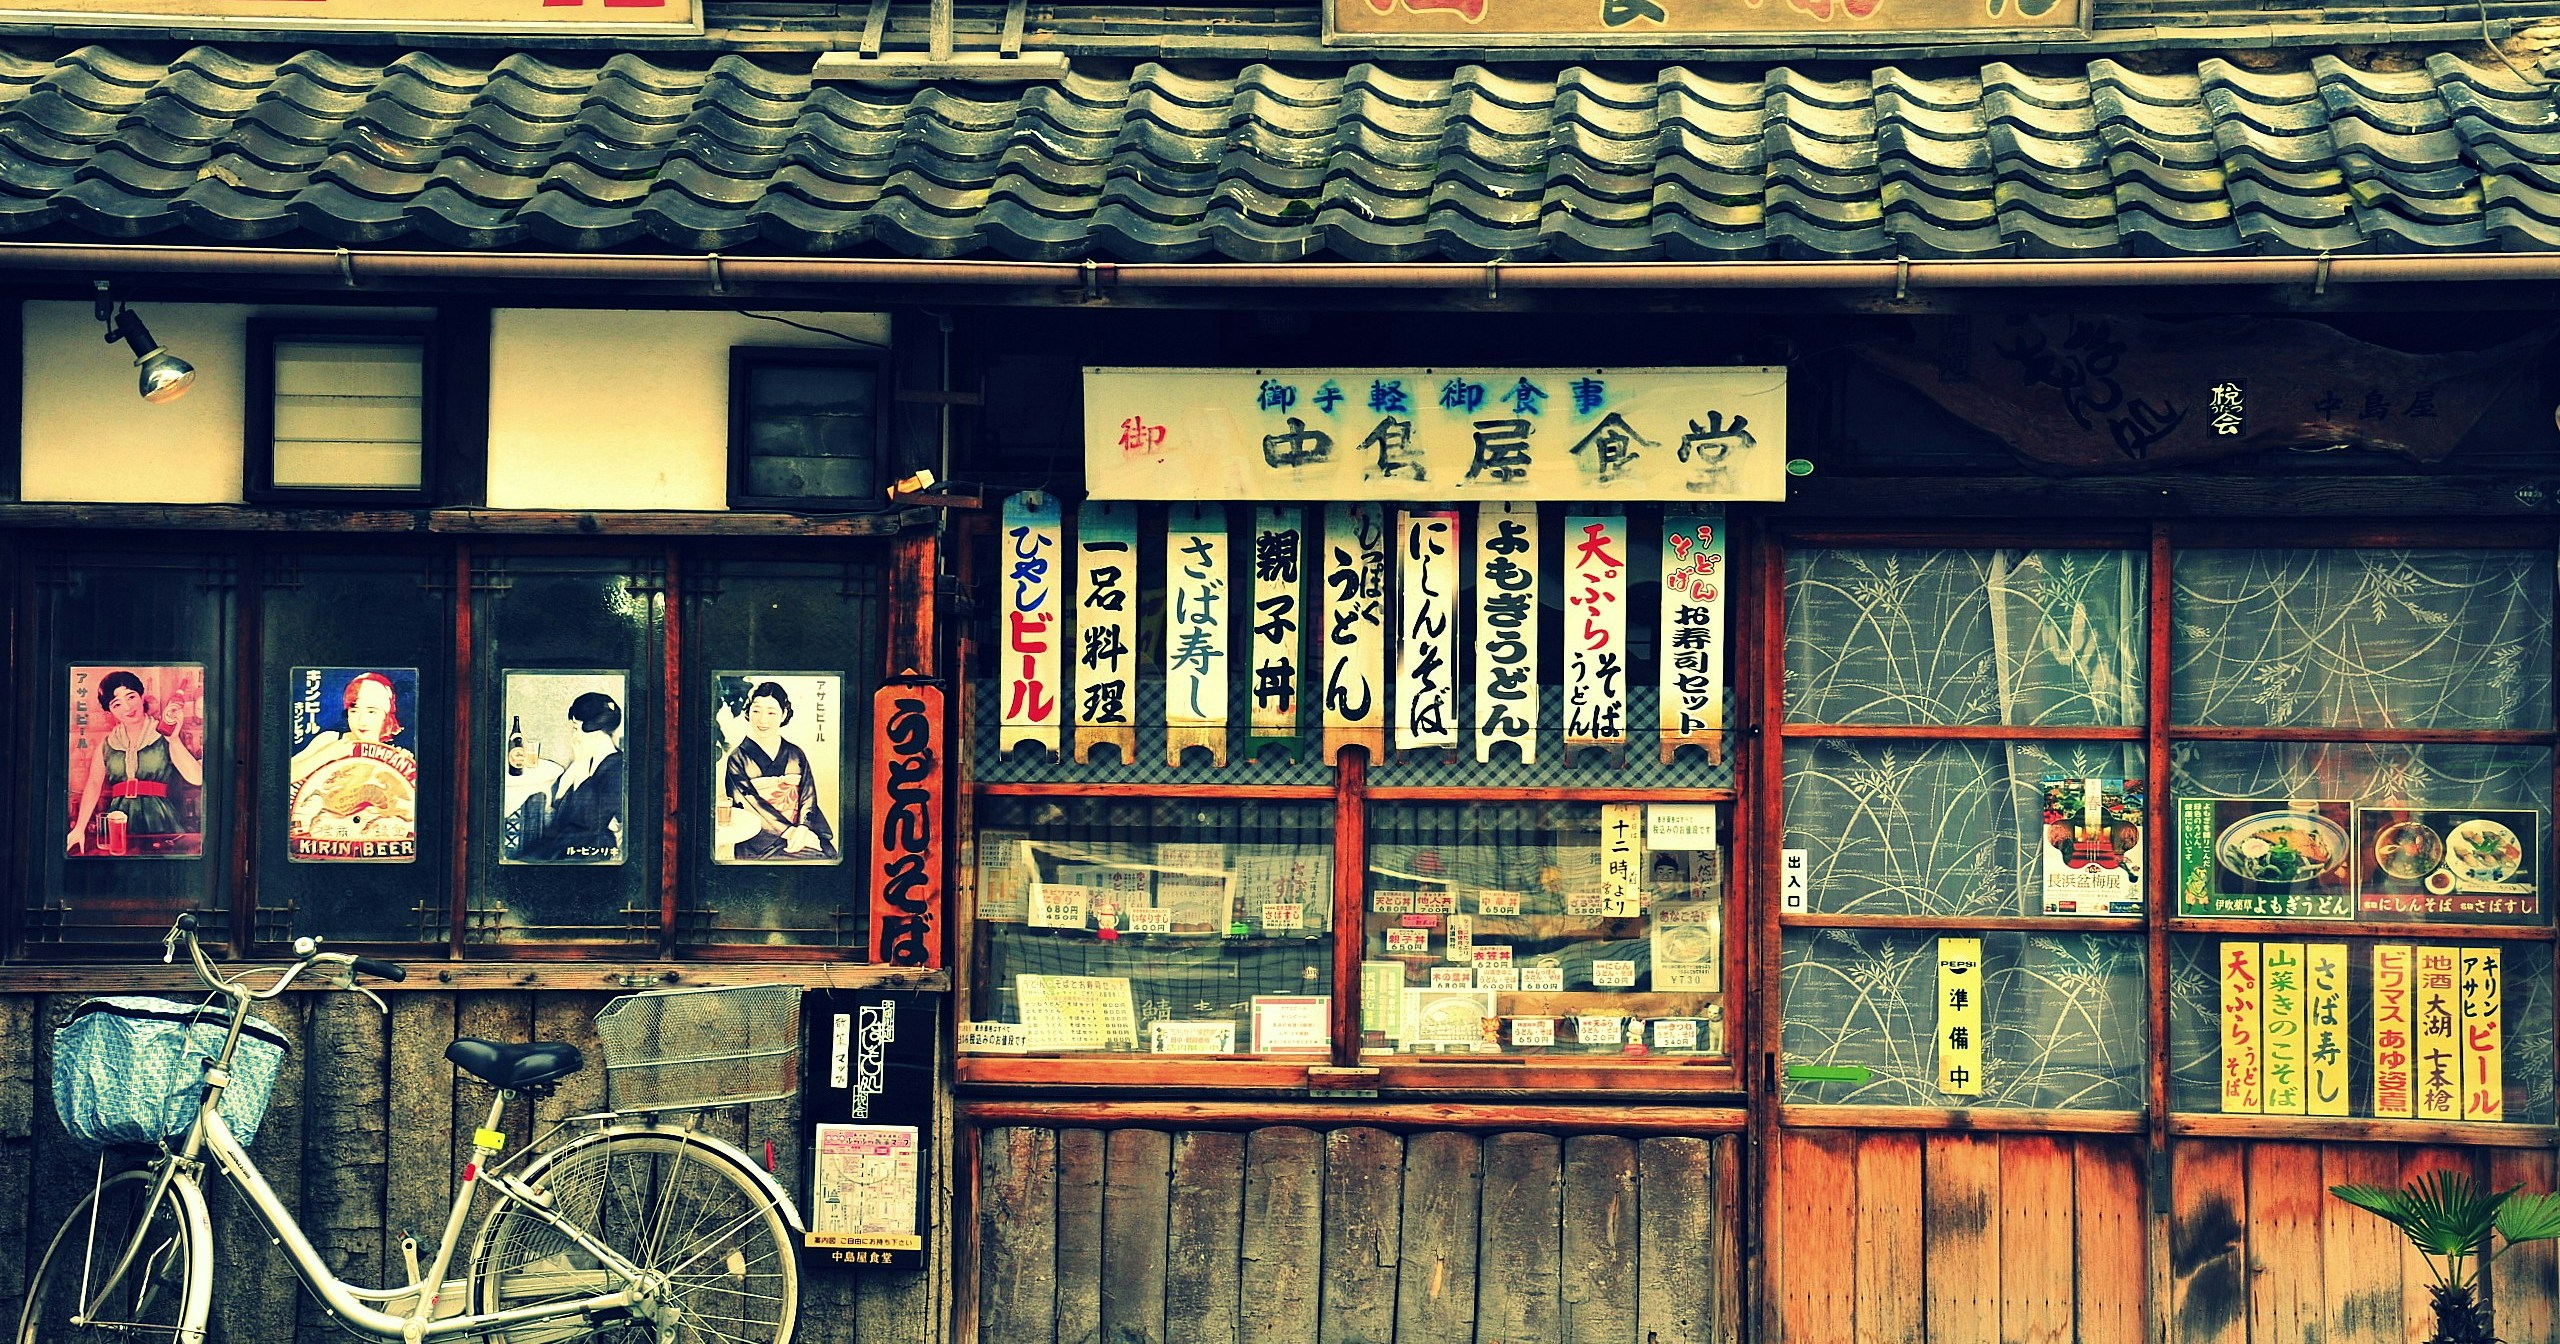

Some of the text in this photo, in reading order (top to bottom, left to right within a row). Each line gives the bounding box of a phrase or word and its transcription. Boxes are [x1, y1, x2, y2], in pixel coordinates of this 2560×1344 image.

[1257, 378, 1607, 416] 御手軽御食事
[1118, 414, 1166, 462] 御
[1262, 409, 1758, 493] 中島屋食堂
[1569, 523, 1625, 651] 天ぷら
[1666, 533, 1694, 592] そば
[1690, 524, 1722, 603] うどん
[1005, 526, 1054, 723] ひやしビール
[1081, 541, 1130, 725] 一品料理
[1169, 535, 1225, 719] さば寿し
[1253, 529, 1301, 713] 親子丼
[1326, 546, 1372, 722] うどん
[1408, 521, 1450, 737] にしんそば
[1481, 519, 1534, 738] よもぎうどん
[304, 669, 322, 735] キリンビール
[1567, 652, 1589, 738] うどん
[1591, 652, 1623, 739] そば
[1671, 604, 1712, 736] お寿司セット
[76, 672, 88, 750] アサヒビール
[815, 680, 827, 743] アサヒビール
[299, 838, 415, 858] KIRIN-BEER
[880, 698, 932, 966] うどんそば
[1609, 819, 1630, 916] 十二時より
[1046, 904, 1079, 914] 680円
[1264, 910, 1300, 920] さばすし
[1417, 896, 1454, 905] 他人丼
[1485, 906, 1515, 914] 650円
[1787, 856, 1801, 908] 出入口
[2215, 894, 2350, 915] 伊吹薬草 よもぎうどん
[2378, 897, 2454, 913] にしんそば
[2475, 899, 2533, 915] さばすし
[1131, 914, 1169, 924] いなりすし
[1388, 934, 1427, 945] 親子丼
[1605, 962, 1631, 971] にしん
[1941, 960, 1976, 968] PEPSI
[2225, 950, 2256, 1047] 天ぷら
[2462, 957, 2479, 1018] アサヒ
[2480, 956, 2500, 1018] キリン
[1948, 988, 1970, 1089] 準備中
[2267, 949, 2299, 1108] 山菜きのこそば
[2311, 957, 2342, 1103] さば寿し
[2378, 951, 2407, 1113] ビワマス あゆ姿煮
[2421, 954, 2455, 1112] 地酒 大湖 七本槍
[2225, 1057, 2240, 1098] そば
[2242, 1046, 2258, 1107] うどん
[2467, 1022, 2501, 1115] ビール
[814, 1236, 913, 1247] 案内図 ご自由にお持ち下さい
[831, 1250, 893, 1264] 中島屋食堂
